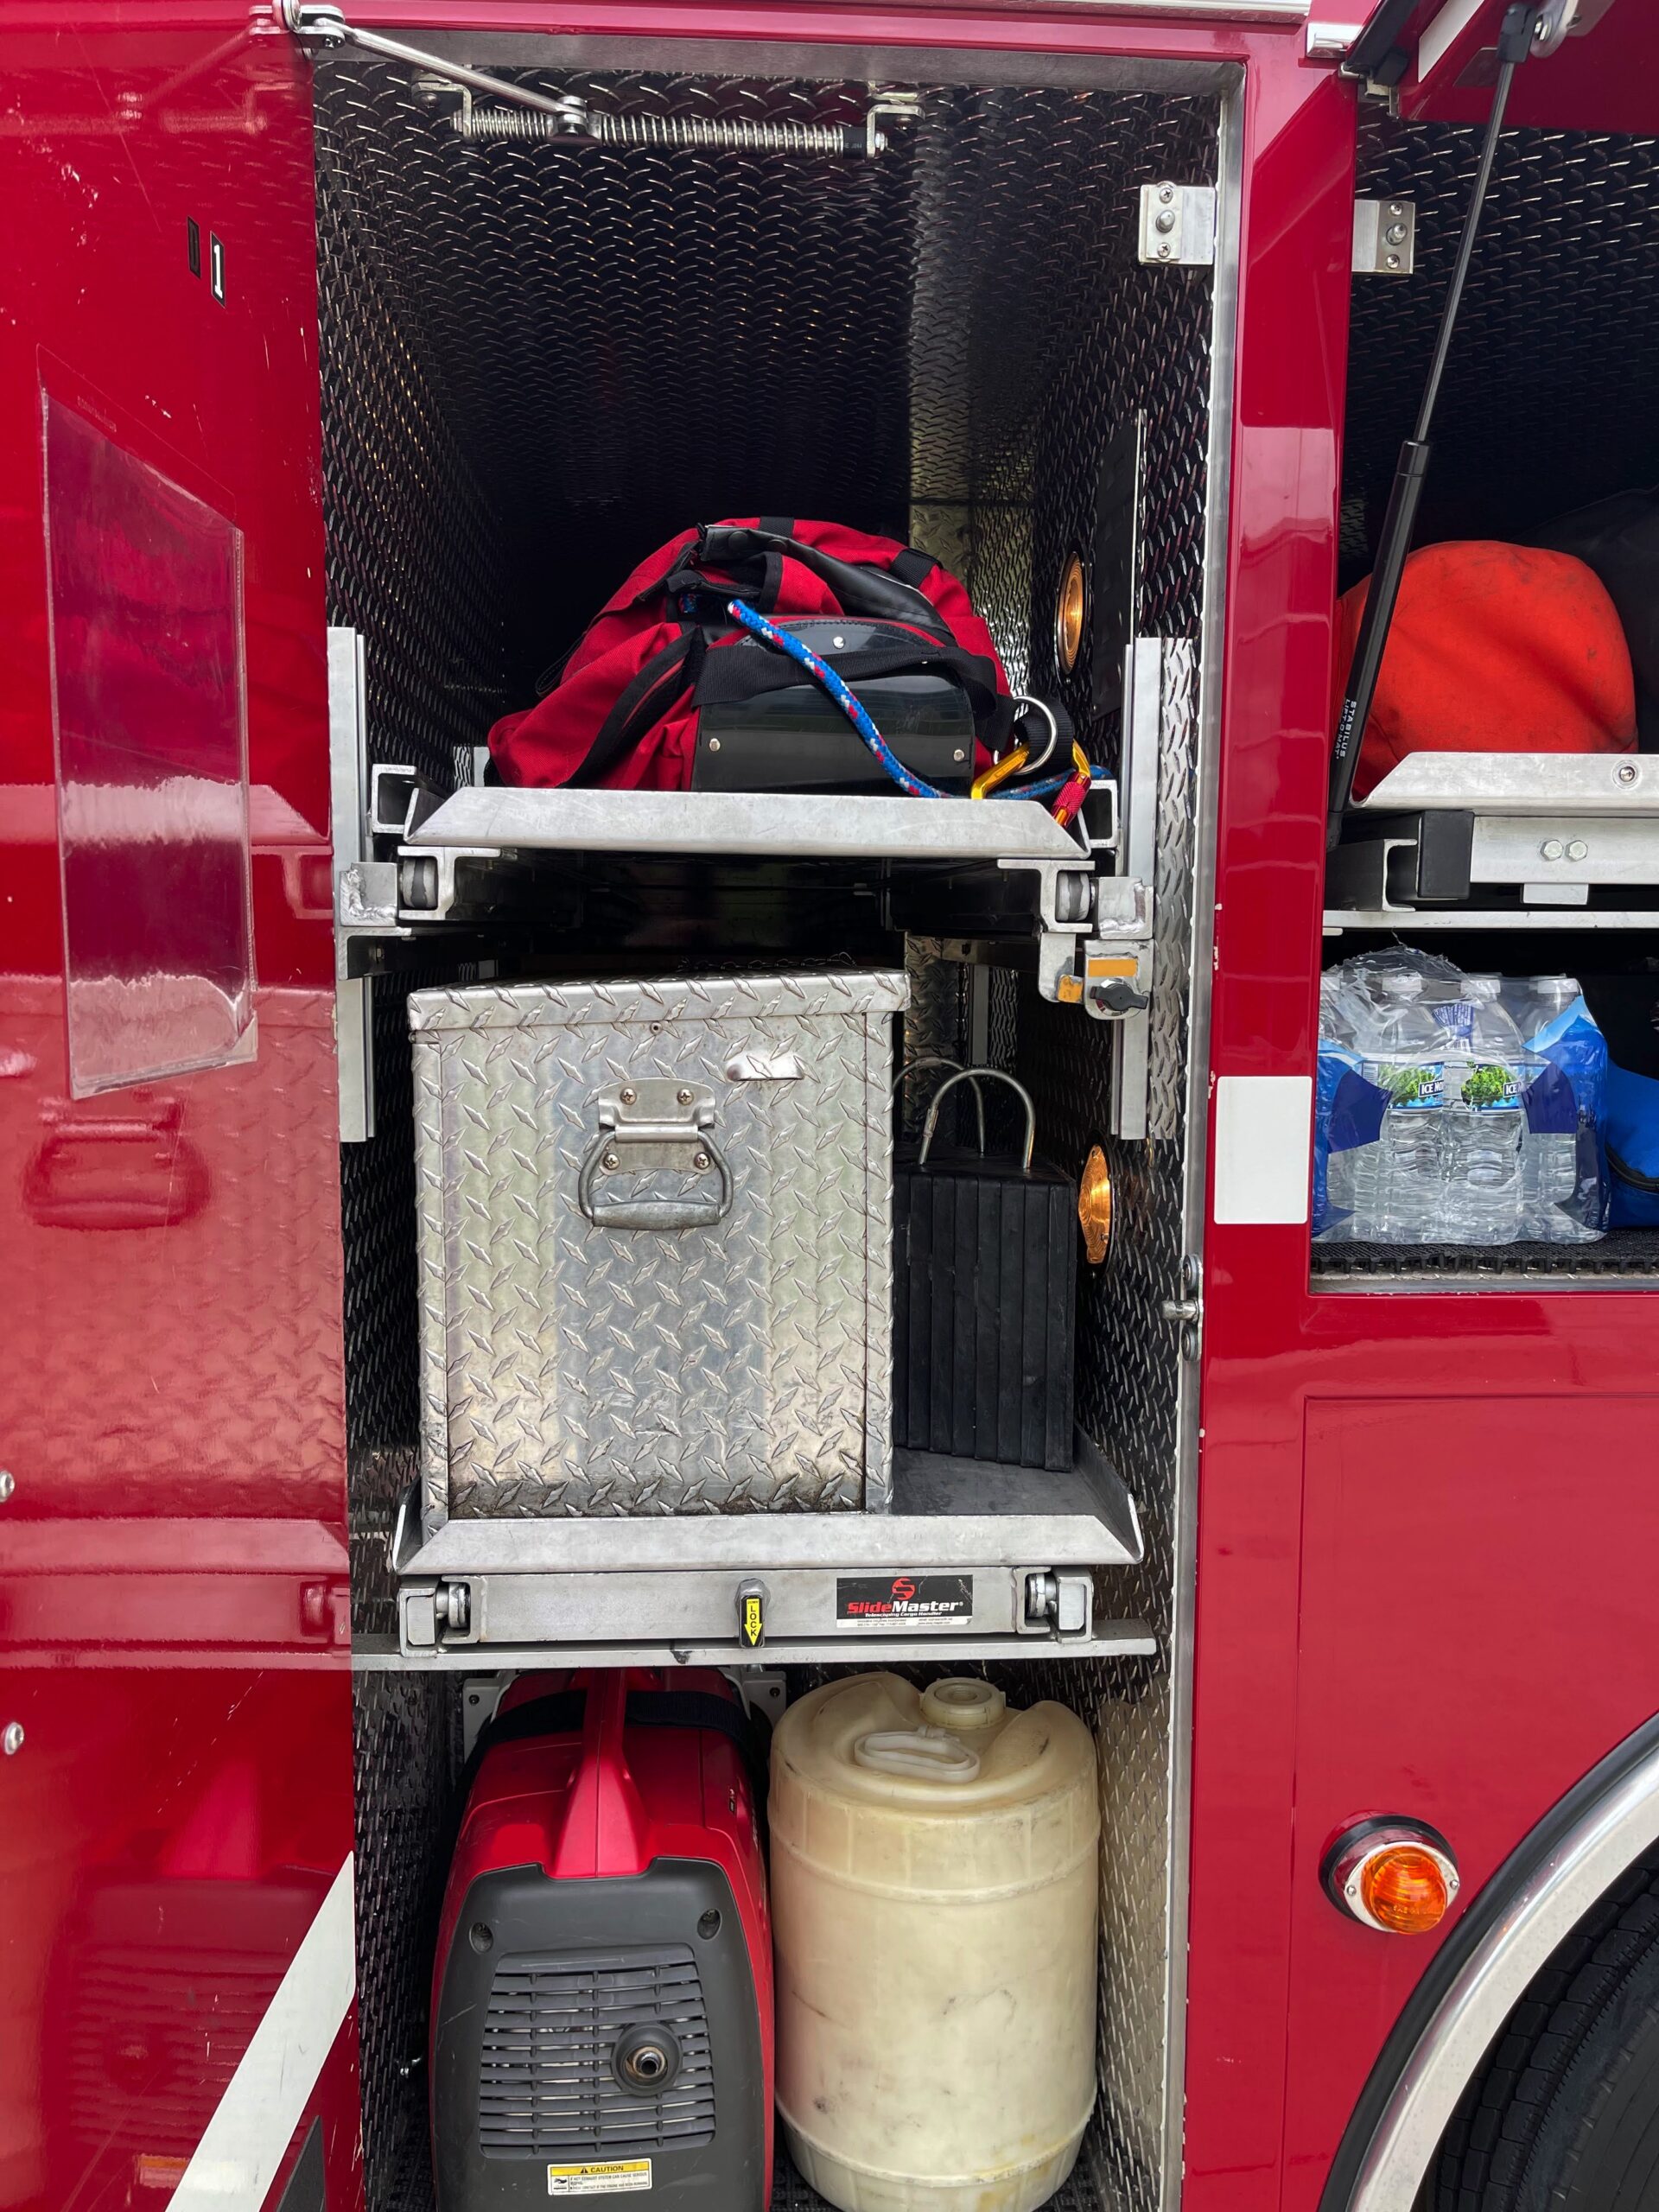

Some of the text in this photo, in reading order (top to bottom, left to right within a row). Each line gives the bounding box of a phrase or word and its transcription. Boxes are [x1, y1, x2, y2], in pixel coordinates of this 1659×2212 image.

[213, 244, 224, 299] 1
[1339, 701, 1357, 757] STABILUS
[1421, 1083, 1434, 1095] ICE
[1505, 1083, 1518, 1095] ICE
[749, 1605, 758, 1637] LOCK
[590, 2164, 624, 2174] CAUTION
